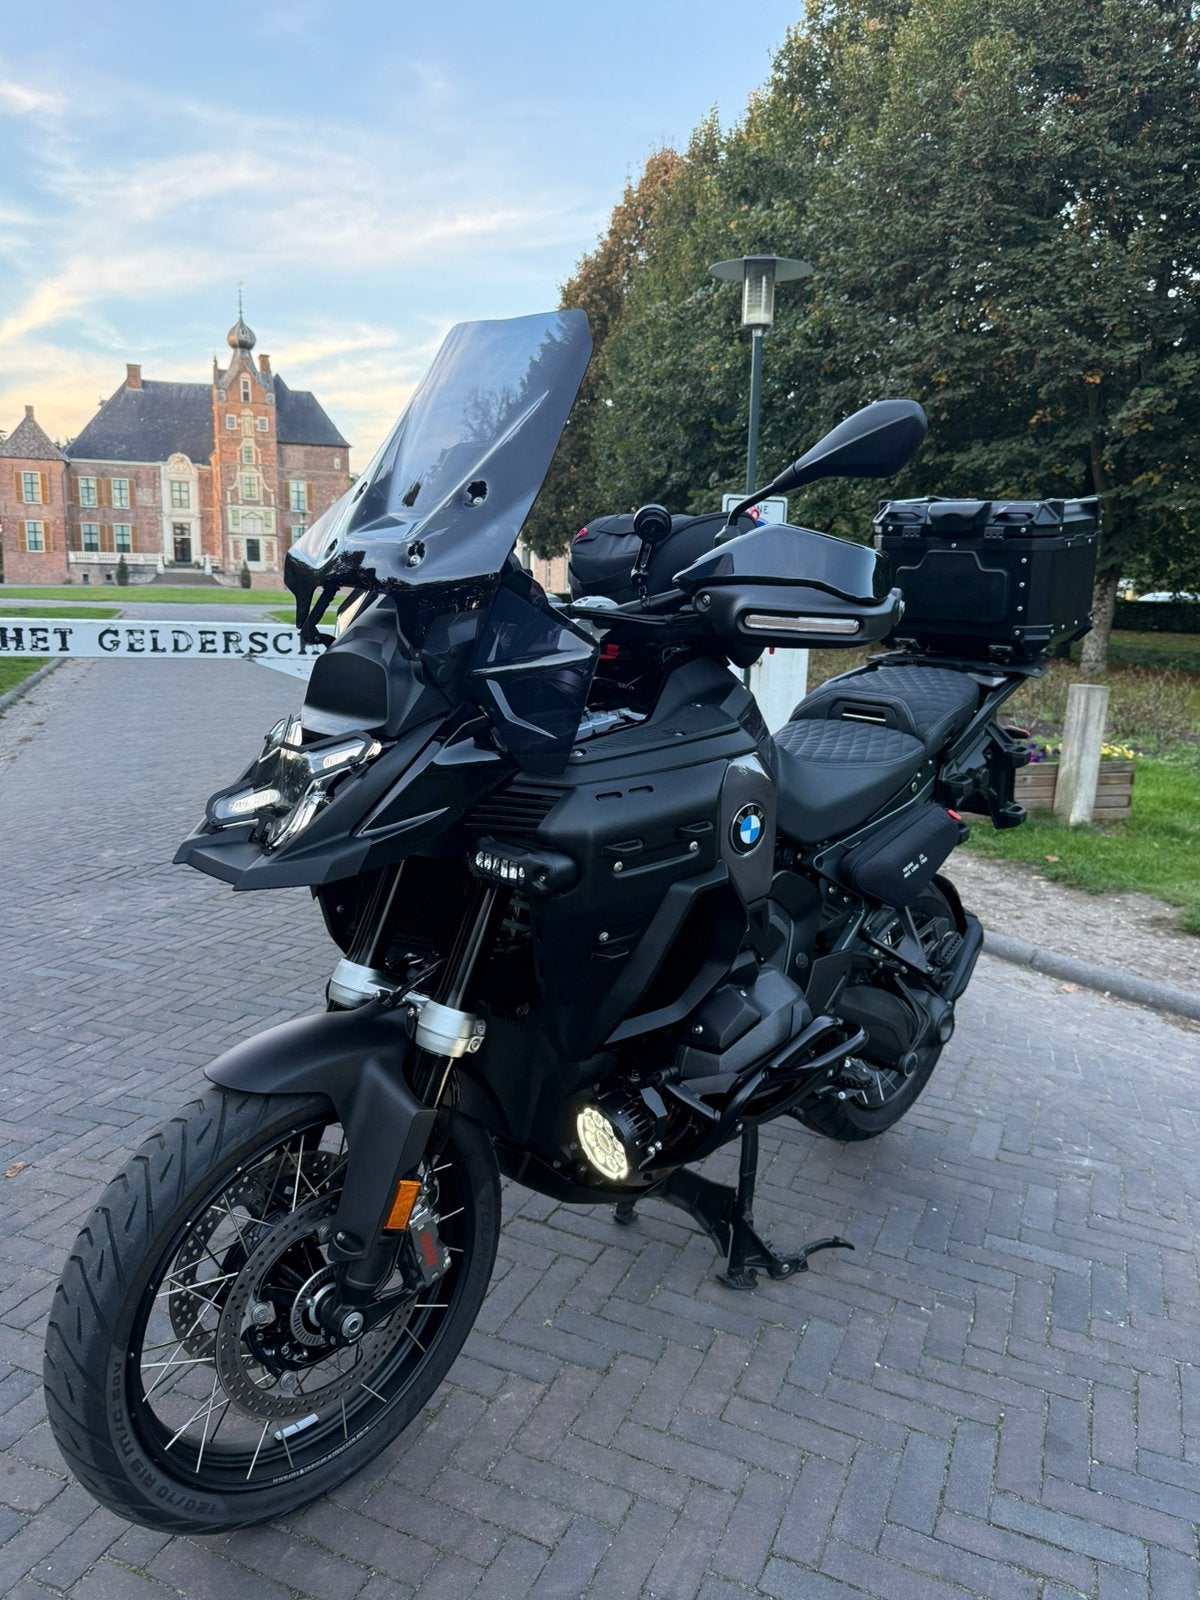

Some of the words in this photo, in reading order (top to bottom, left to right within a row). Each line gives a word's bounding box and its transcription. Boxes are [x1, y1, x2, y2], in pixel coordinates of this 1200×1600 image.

[0, 627, 73, 651] HET
[737, 806, 764, 824] BMW
[156, 1485, 216, 1515] 120/70
